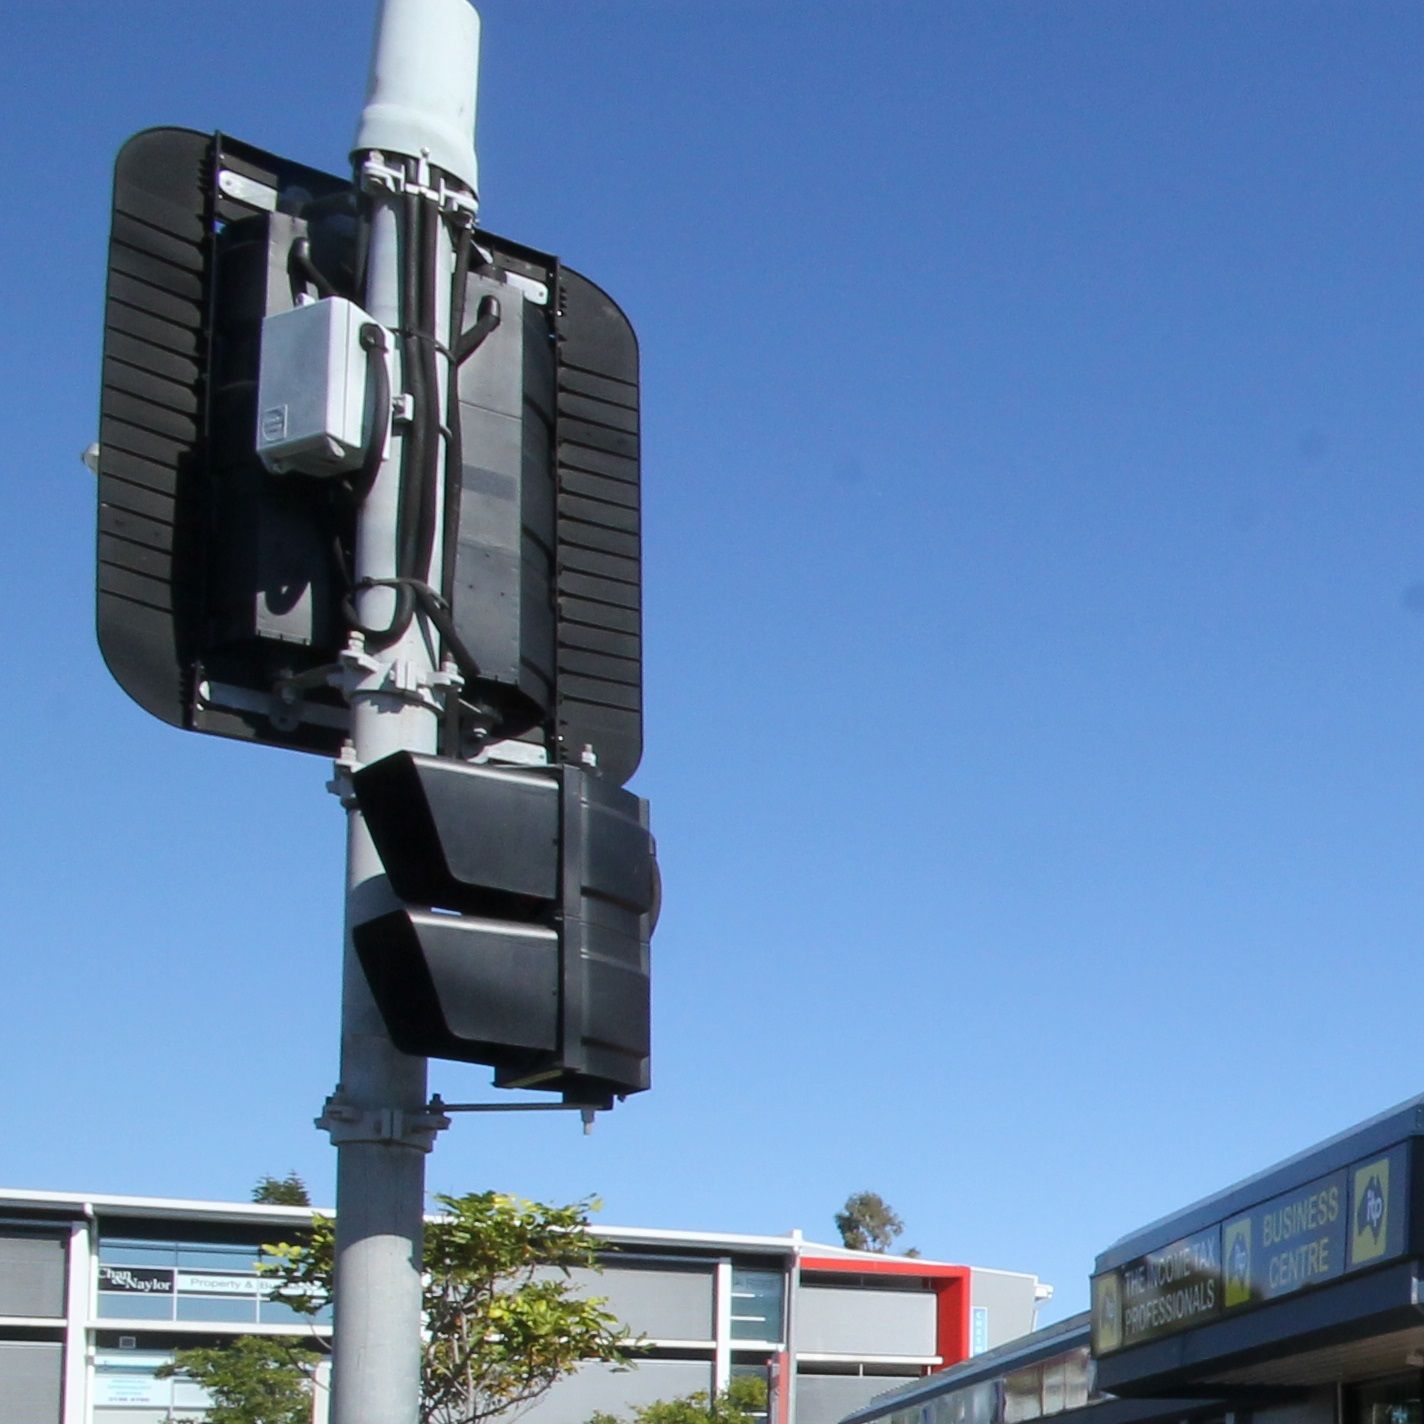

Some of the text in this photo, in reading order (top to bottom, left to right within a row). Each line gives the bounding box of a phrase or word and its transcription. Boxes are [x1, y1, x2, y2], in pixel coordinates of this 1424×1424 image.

[1263, 1186, 1339, 1248] BUSINESS
[98, 1267, 131, 1280] Chan
[125, 1278, 171, 1292] Naylor
[190, 1278, 241, 1290] Property
[1124, 1236, 1216, 1297] THE INCOME TAX
[1269, 1237, 1330, 1289] CENTRE
[1125, 1279, 1216, 1335] PROFESSIONALS
